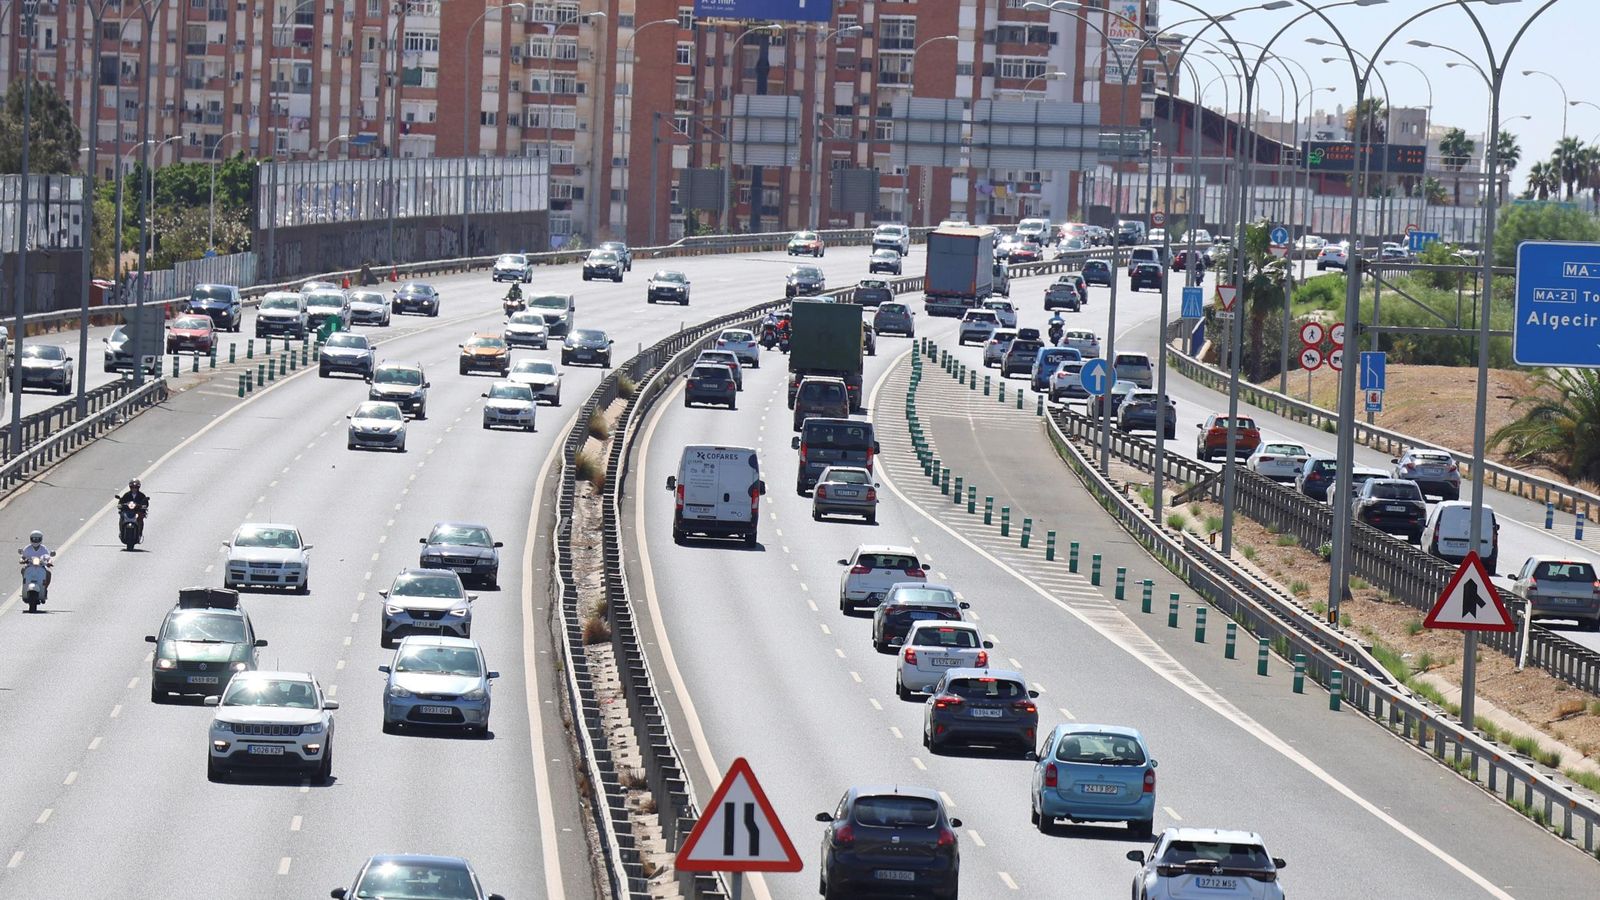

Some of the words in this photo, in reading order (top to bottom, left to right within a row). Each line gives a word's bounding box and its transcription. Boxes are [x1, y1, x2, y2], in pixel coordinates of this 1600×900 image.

[1109, 29, 1137, 37] DANY
[1566, 264, 1600, 276] MA-
[1536, 290, 1575, 301] MA-21
[1583, 291, 1600, 303] To
[1526, 311, 1598, 330] Algecir
[706, 452, 739, 460] COFARES
[252, 746, 269, 754] 5026
[1201, 878, 1221, 887] 3712
